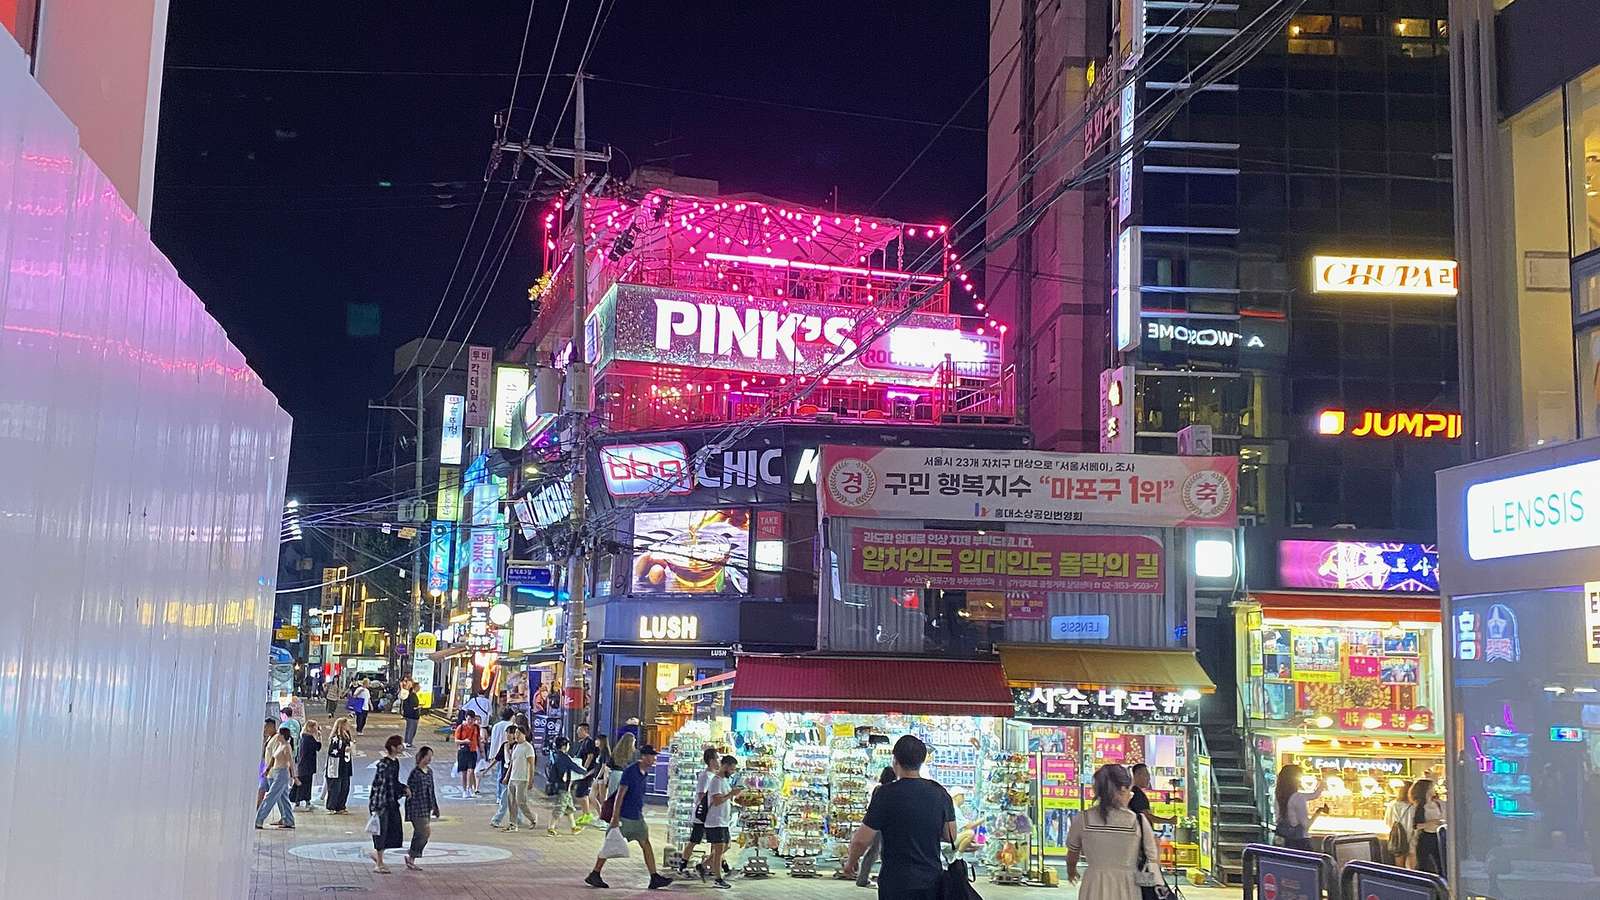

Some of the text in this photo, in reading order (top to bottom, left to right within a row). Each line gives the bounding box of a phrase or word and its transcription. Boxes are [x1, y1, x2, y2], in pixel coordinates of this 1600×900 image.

[654, 297, 860, 368] PINK'S
[924, 456, 953, 467] 서울시
[955, 457, 979, 468] 23개
[982, 457, 1011, 469] 자치구
[1014, 459, 1053, 471] 대상으로
[1115, 461, 1135, 473] 조사
[841, 472, 862, 494] 경
[884, 472, 930, 496] 구민
[938, 473, 1032, 499] 행복지수
[1196, 482, 1218, 505] 축
[760, 516, 779, 525] TAKE
[1491, 489, 1585, 534] LENSSIS
[927, 534, 948, 545] 인상
[862, 545, 1159, 579] 임차인도 임대인도 몰락의 길
[639, 615, 698, 640] LUSH
